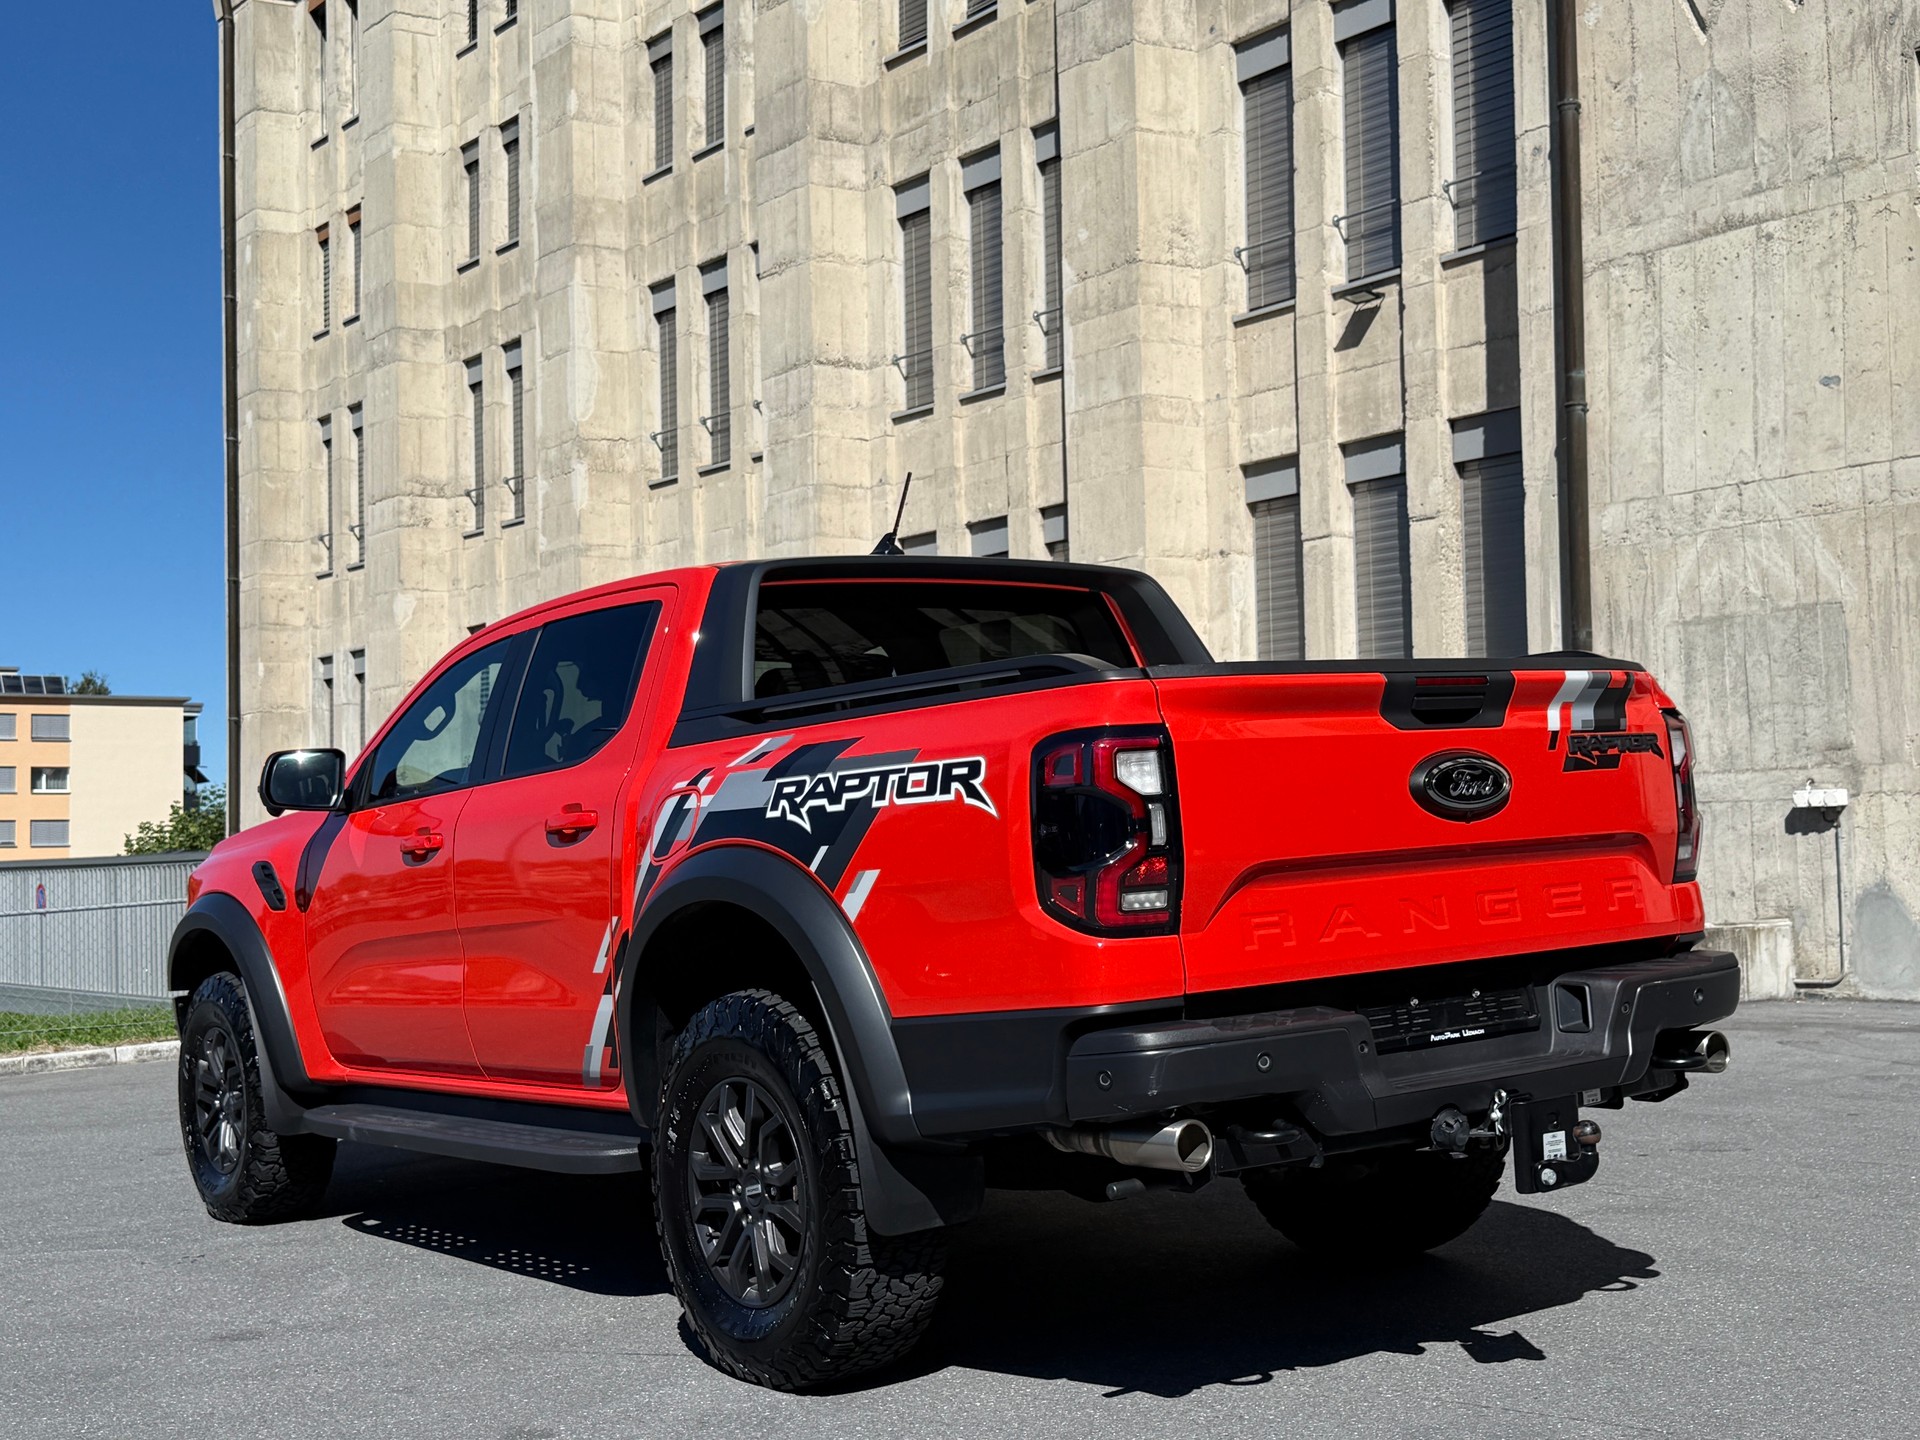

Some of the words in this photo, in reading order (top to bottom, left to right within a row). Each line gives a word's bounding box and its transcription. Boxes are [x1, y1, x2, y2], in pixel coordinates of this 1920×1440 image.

[1568, 734, 1664, 762] RAPTOR
[765, 756, 1000, 834] RAPTOR
[1450, 769, 1494, 797] Ford
[1240, 874, 1645, 952] RANGER
